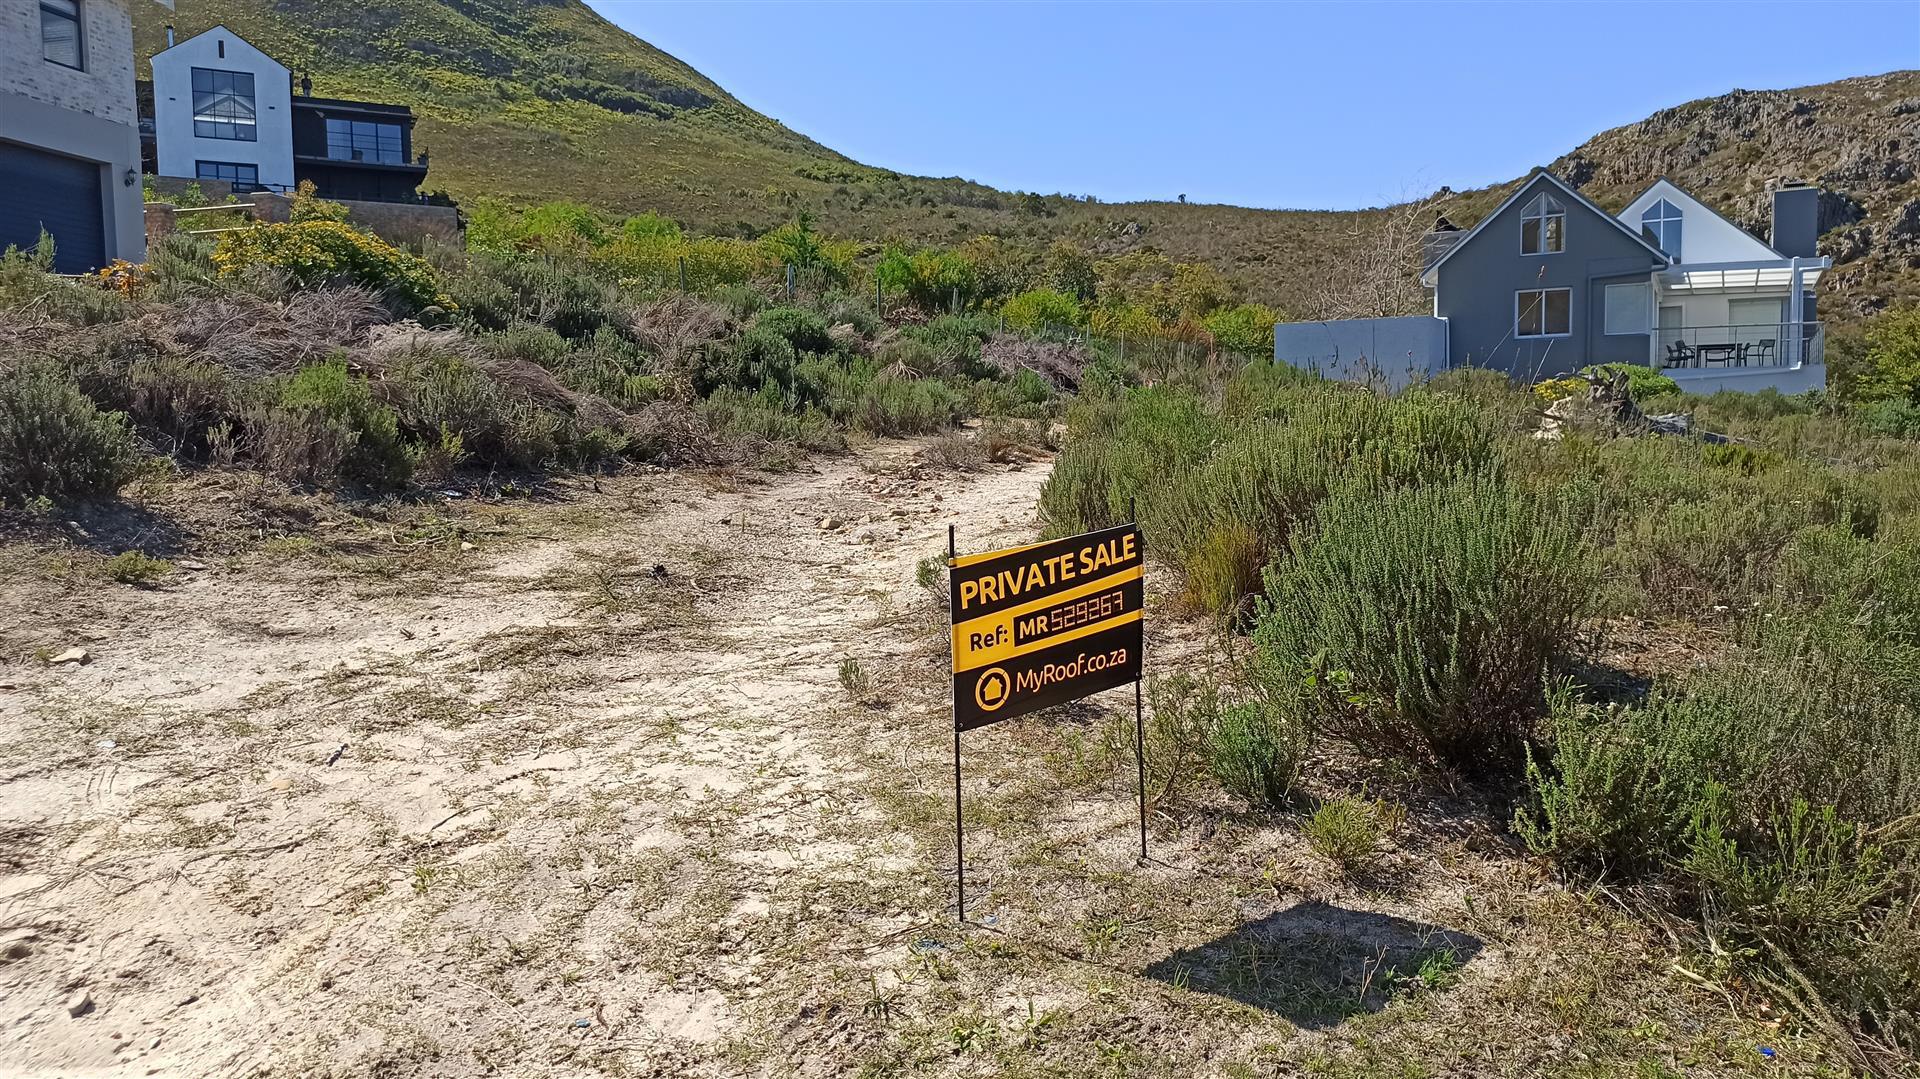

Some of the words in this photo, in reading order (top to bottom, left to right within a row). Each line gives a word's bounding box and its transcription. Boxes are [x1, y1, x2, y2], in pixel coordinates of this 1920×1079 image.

[960, 552, 1076, 610] PRIVATE
[1079, 533, 1137, 575] SALE
[970, 624, 1009, 652] Ref:
[1016, 648, 1127, 693] MyRoof.co.za
